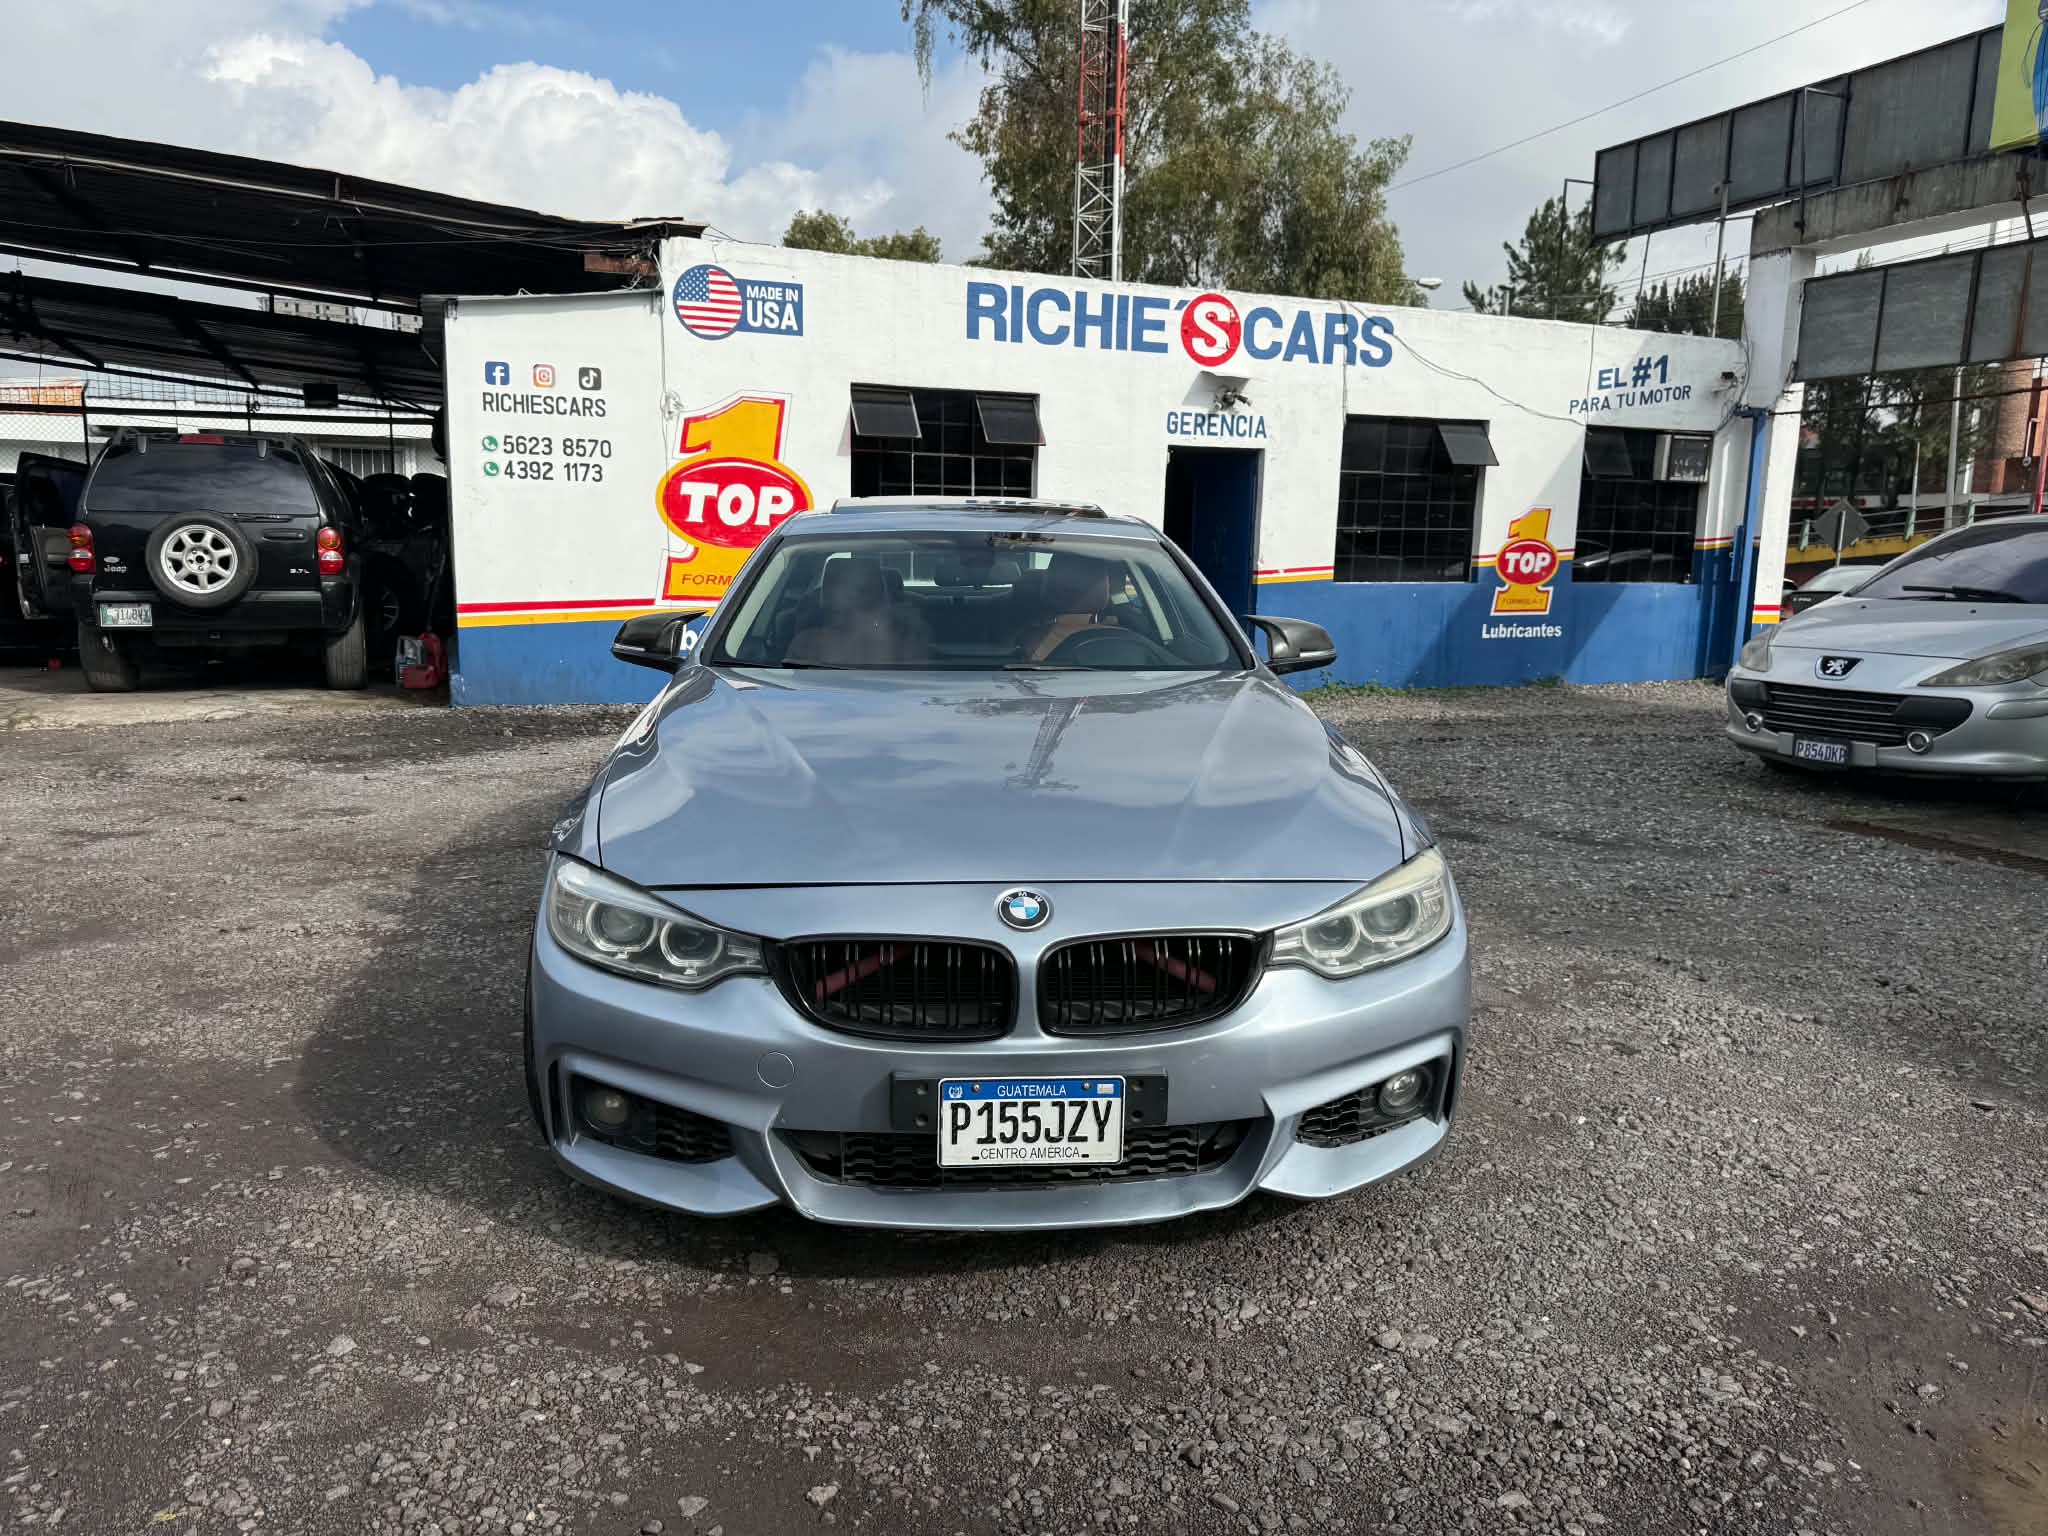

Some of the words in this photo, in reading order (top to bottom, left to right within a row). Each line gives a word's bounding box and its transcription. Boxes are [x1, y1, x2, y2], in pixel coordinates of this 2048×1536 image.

[747, 285, 783, 300] MADE
[785, 287, 799, 302] IN
[747, 299, 799, 331] USA
[1243, 306, 1394, 368] CARS
[1597, 367, 1628, 390] EL
[1631, 354, 1669, 388] #1
[482, 391, 607, 418] RICHIESCARS
[1569, 396, 1612, 415] PARA
[1616, 391, 1636, 409] TU
[1639, 385, 1692, 406] MOTOR
[1166, 411, 1268, 439] GERENCIA
[503, 435, 553, 456] 5623
[562, 438, 612, 459] 8570
[504, 460, 554, 481] 4392
[563, 462, 604, 482] 1173
[680, 480, 795, 528] TOP
[1504, 550, 1552, 574] TOP
[1481, 623, 1563, 639] Lubricantes
[997, 1085, 1067, 1098] GUATEMALA
[950, 1100, 1113, 1145] P155JZY
[980, 1147, 1027, 1160] CENTRO
